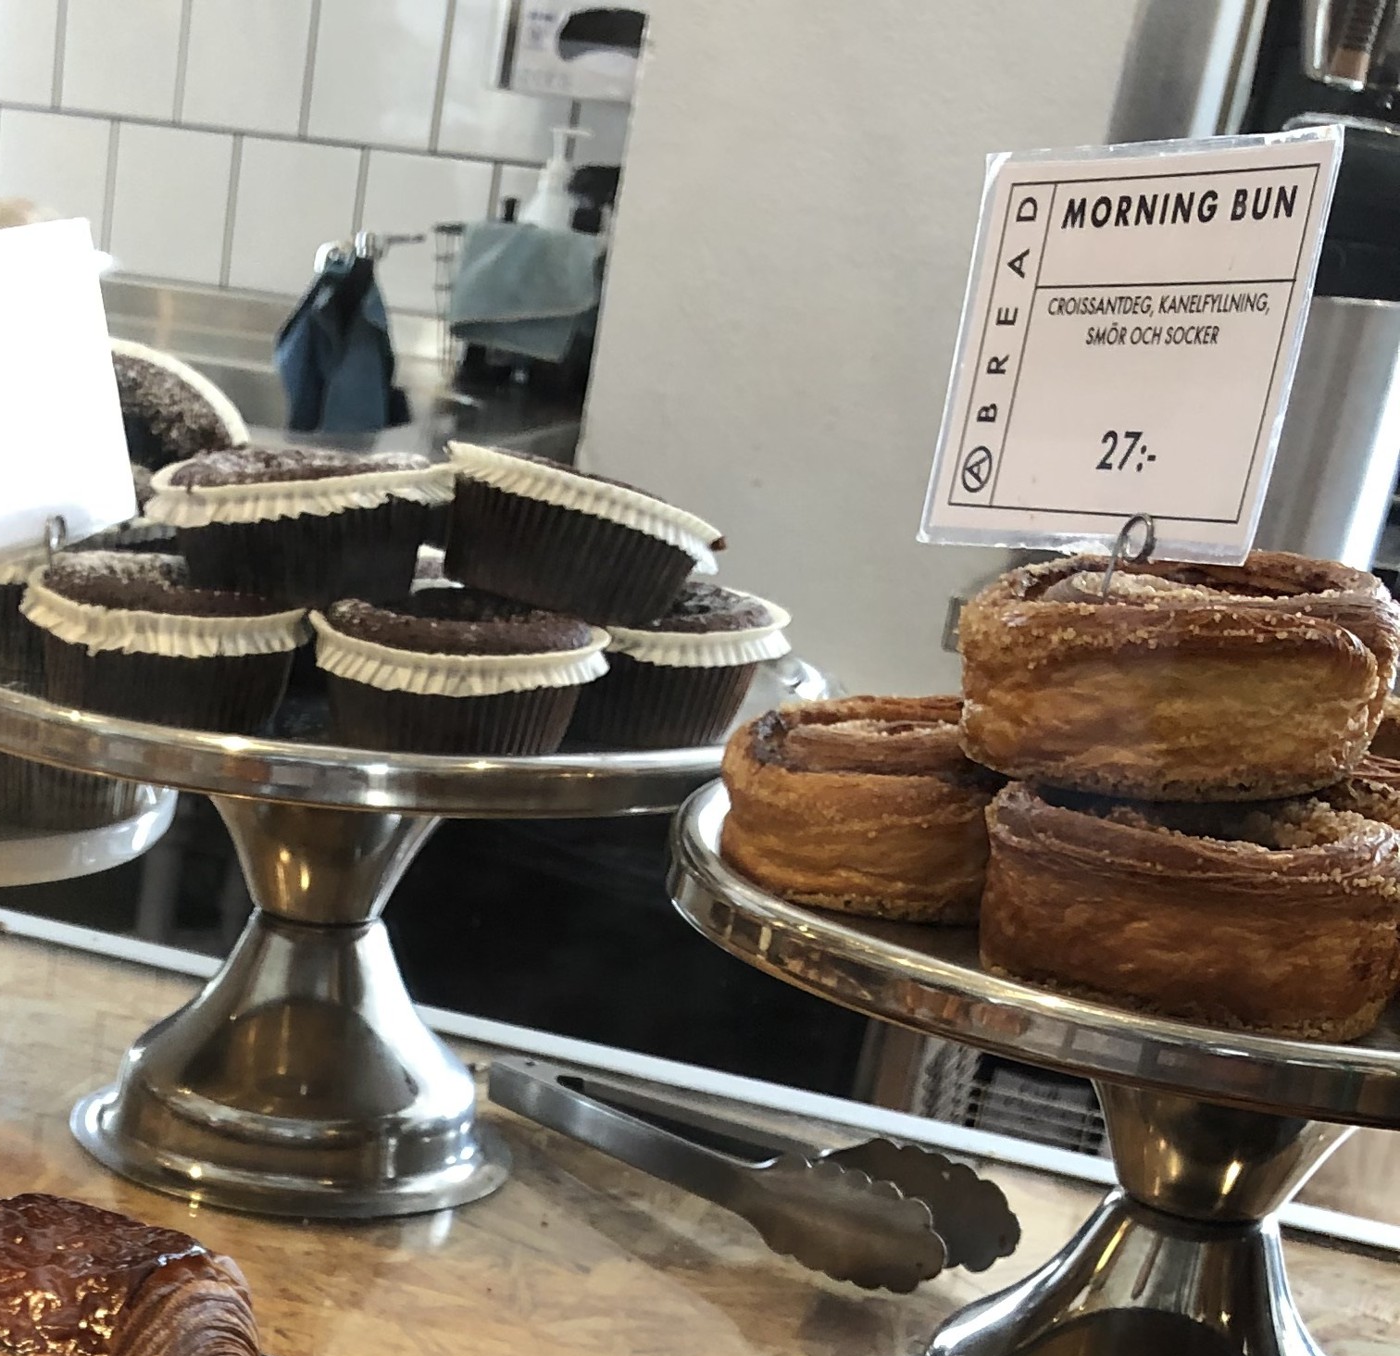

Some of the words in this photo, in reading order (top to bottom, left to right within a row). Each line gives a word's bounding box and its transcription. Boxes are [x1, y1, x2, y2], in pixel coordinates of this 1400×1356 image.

[1060, 190, 1218, 230] MORNING
[1230, 185, 1298, 222] BUN
[976, 195, 1039, 424] BREAD
[1047, 295, 1154, 318] CROISSANTDEG,
[1158, 291, 1271, 316] KANELFYLLNING,
[1086, 321, 1128, 346] SMÖR
[1130, 326, 1163, 346] OCH
[1165, 325, 1220, 346] SOCKER
[1095, 430, 1157, 472] 27:-
